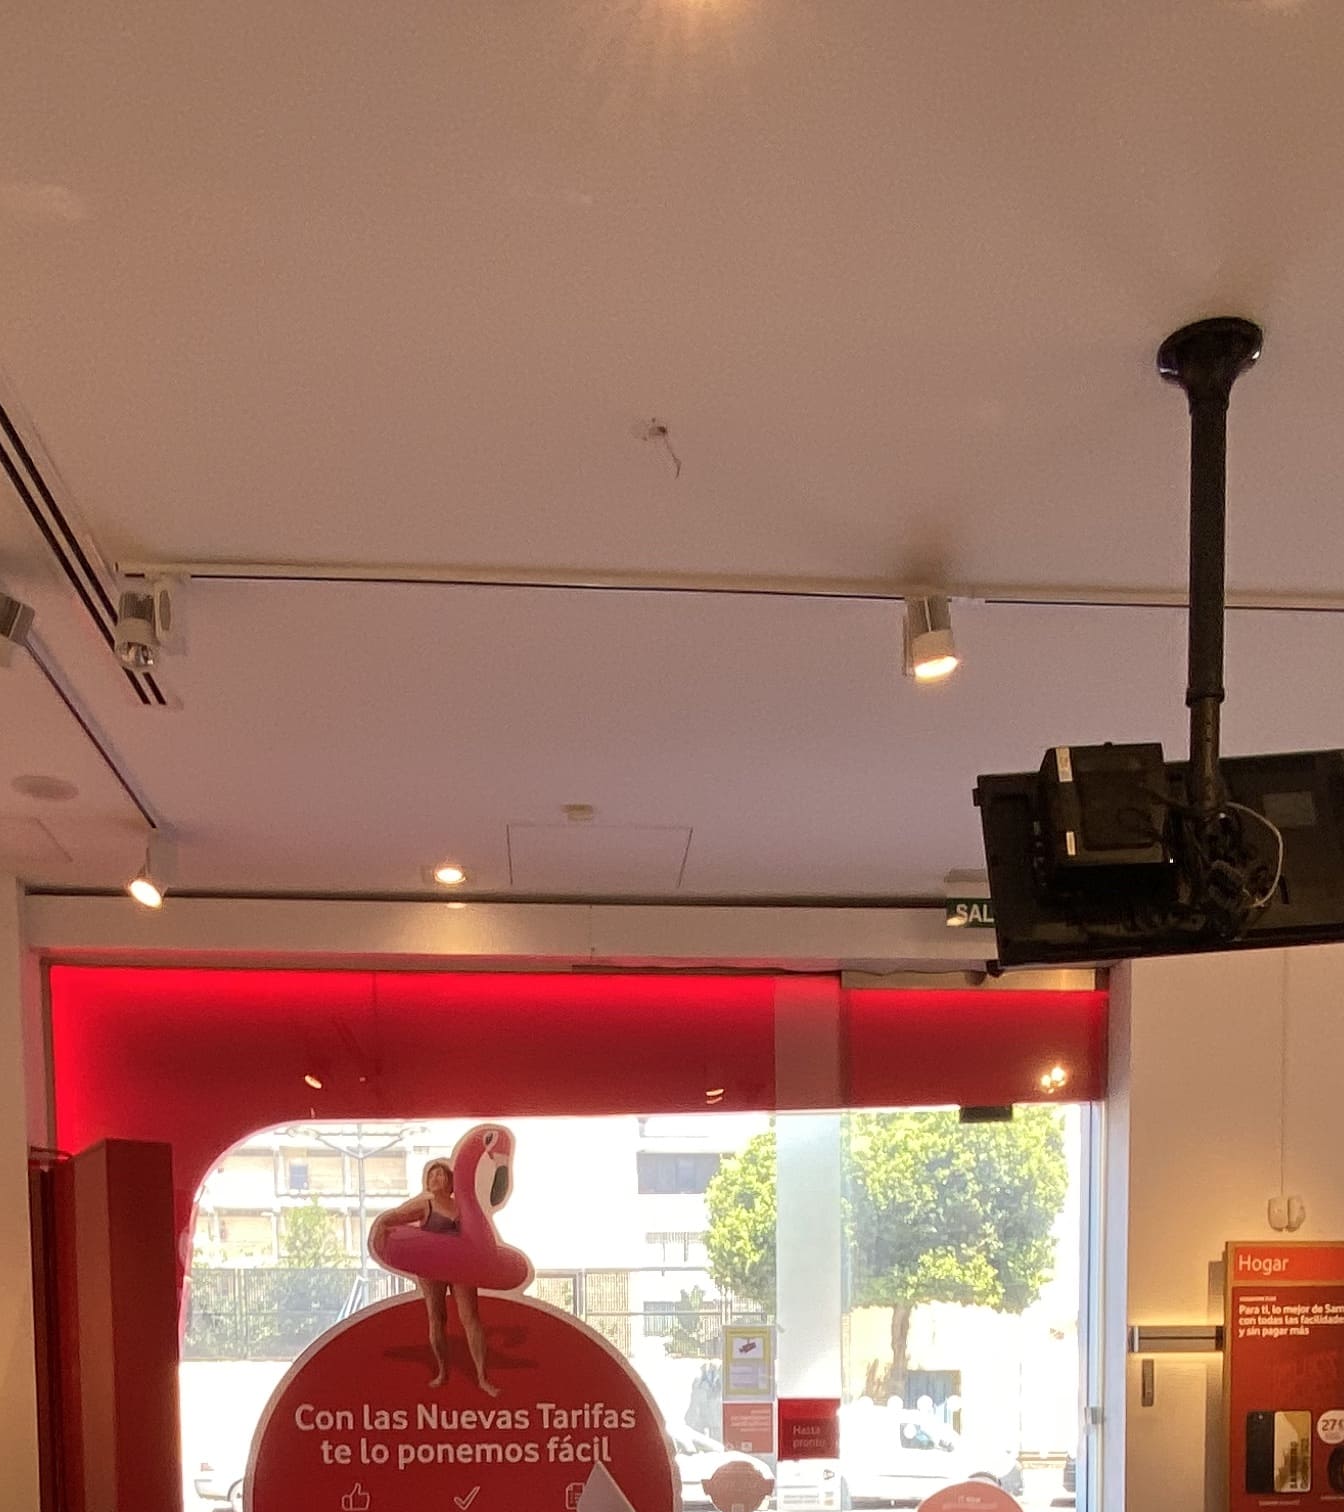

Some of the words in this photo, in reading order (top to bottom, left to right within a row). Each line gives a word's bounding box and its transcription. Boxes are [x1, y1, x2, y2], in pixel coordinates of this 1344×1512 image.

[956, 903, 995, 923] SAL
[1238, 1254, 1289, 1276] Hogar
[1238, 1304, 1260, 1315] Para
[1272, 1304, 1282, 1315] lo
[1283, 1304, 1310, 1316] mejor
[1311, 1304, 1323, 1314] de
[1238, 1316, 1256, 1326] con
[1257, 1315, 1283, 1326] todas
[1285, 1315, 1299, 1325] las
[1238, 1328, 1245, 1338] y
[1246, 1326, 1260, 1336] sin
[1262, 1327, 1289, 1338] pagar
[1290, 1325, 1310, 1336] más
[295, 1403, 354, 1431] Con
[363, 1403, 409, 1431] las
[416, 1403, 530, 1431] Nuevas
[535, 1402, 637, 1430] Tarifas
[321, 1438, 352, 1465] te
[359, 1437, 390, 1465] lo
[398, 1439, 540, 1471] ponemos
[546, 1435, 613, 1464] fácil
